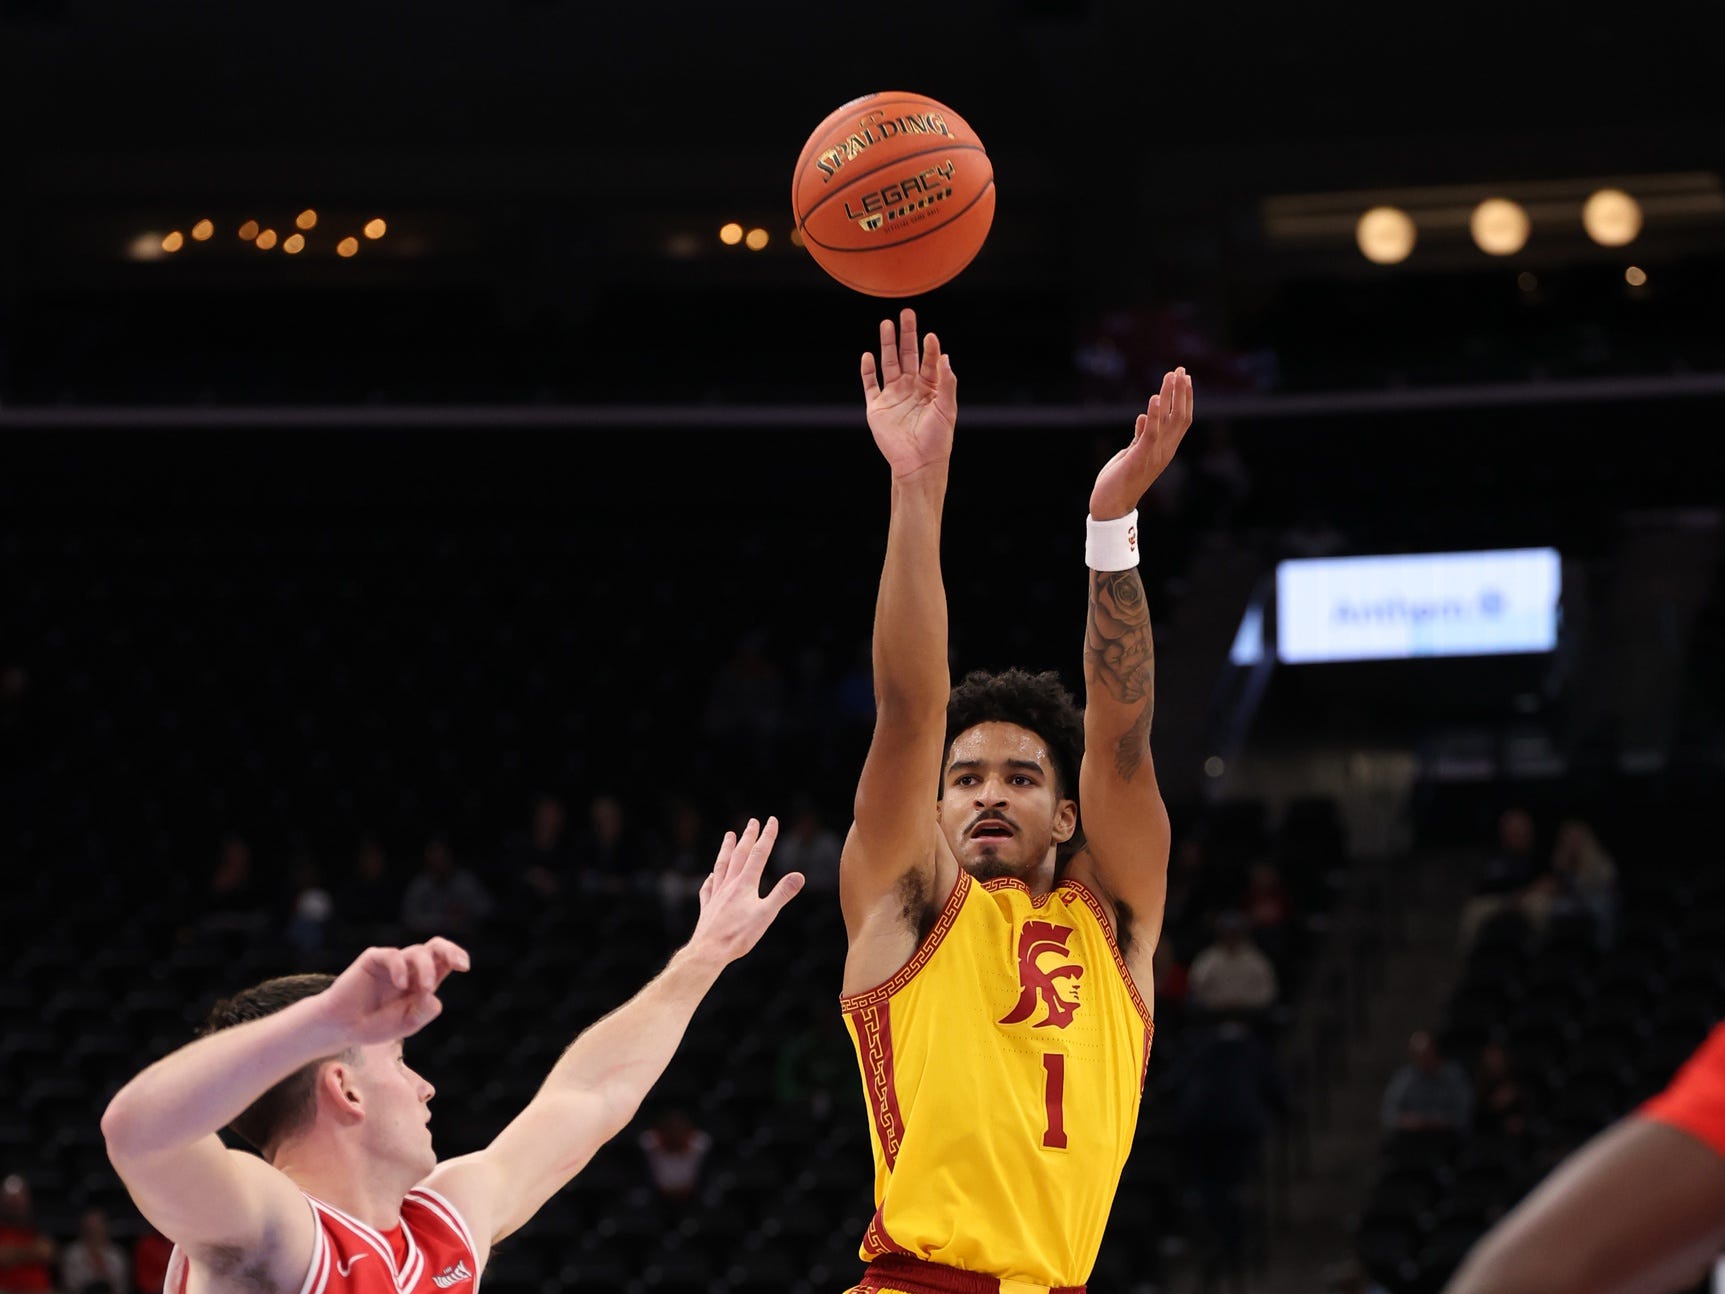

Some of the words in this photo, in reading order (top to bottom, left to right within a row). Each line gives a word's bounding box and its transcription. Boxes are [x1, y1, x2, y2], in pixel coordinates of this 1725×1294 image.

[816, 112, 949, 183] SPALDING
[844, 159, 955, 220] LEGACY
[1042, 1053, 1068, 1149] 1
